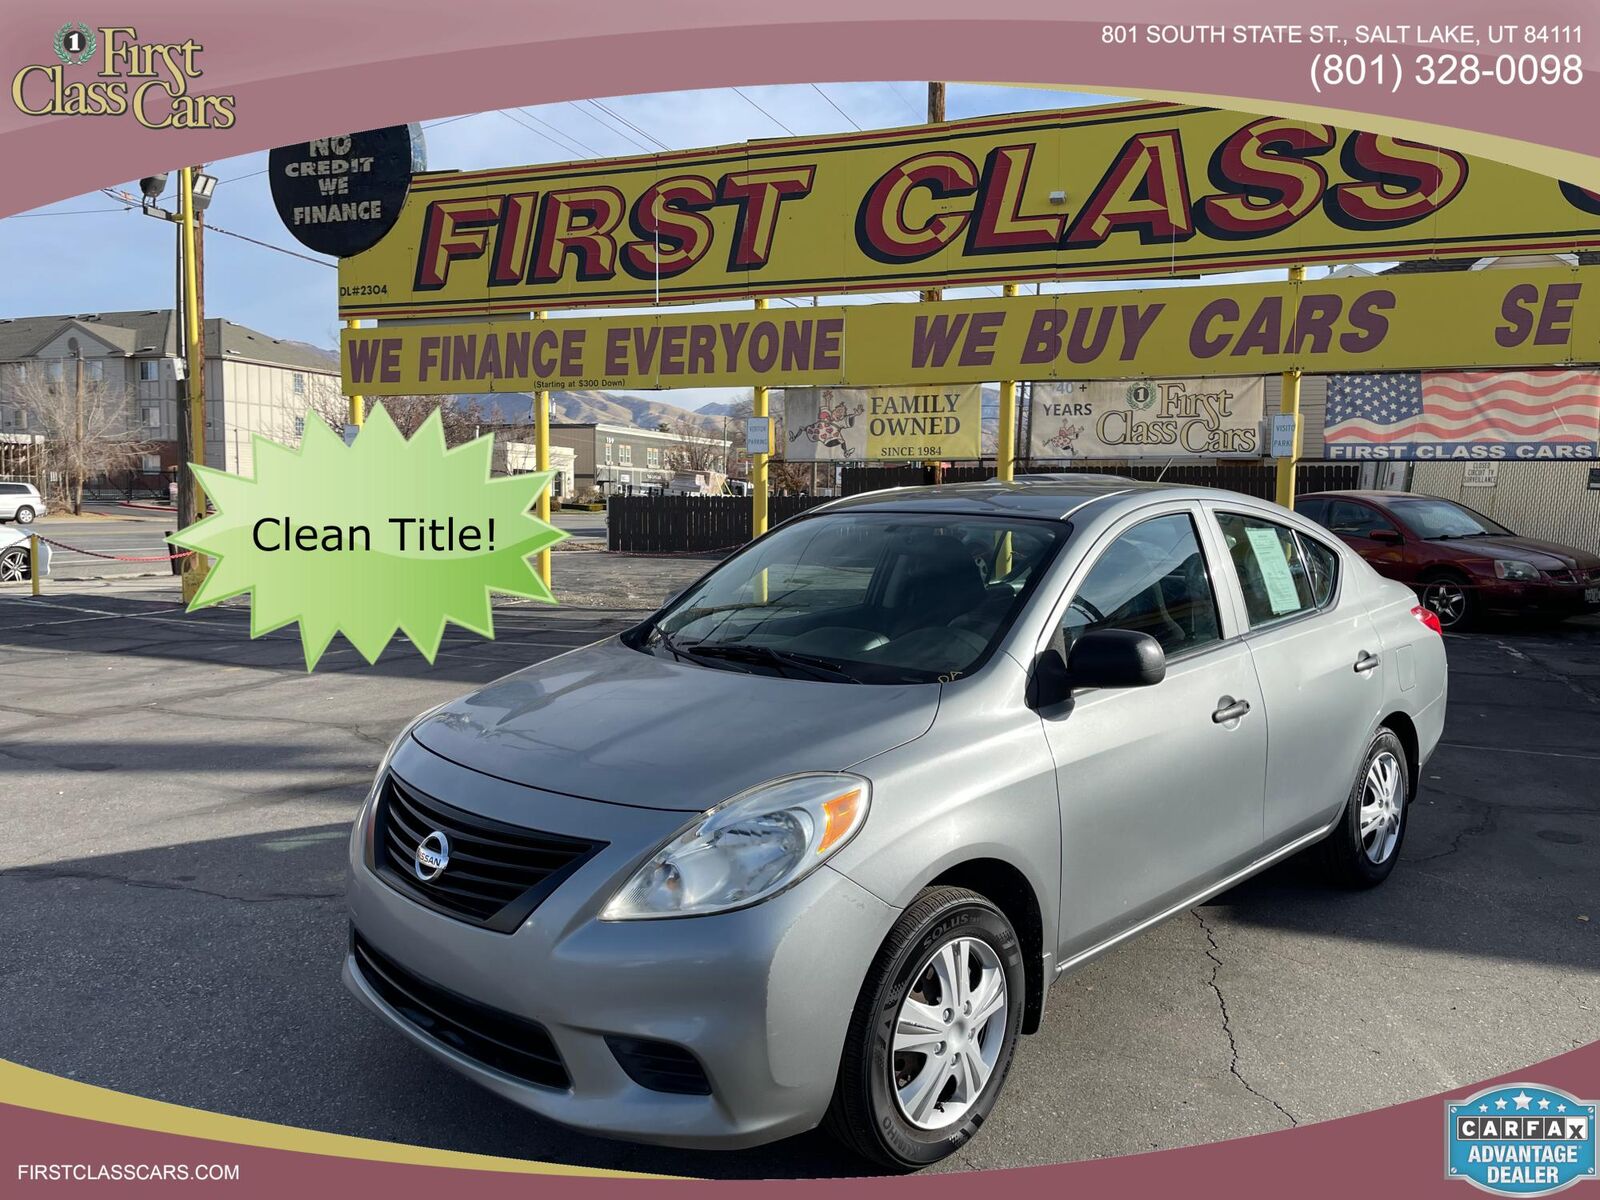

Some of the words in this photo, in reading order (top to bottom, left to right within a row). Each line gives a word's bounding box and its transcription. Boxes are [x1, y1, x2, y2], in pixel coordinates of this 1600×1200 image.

[309, 135, 352, 157] NO
[284, 157, 375, 178] CREDIT
[318, 176, 349, 196] WE
[293, 200, 382, 226] FINANCE
[413, 165, 817, 291] FIRST
[855, 115, 1469, 264] CLASS
[339, 284, 388, 296] DL#2304
[911, 311, 1006, 368] WE
[1020, 303, 1165, 364] BUY
[1188, 290, 1396, 358] CARS
[1494, 283, 1582, 348] SE
[348, 338, 402, 383] WE
[419, 329, 587, 382] FINANCE
[605, 319, 845, 376] EVERYONE
[533, 380, 566, 389] (Starting
[578, 379, 599, 387] $300
[601, 379, 626, 387] Down)
[871, 394, 961, 415] FAMILY
[1043, 403, 1092, 416] YEARS
[1157, 382, 1233, 431] First
[870, 415, 961, 436] OWNED
[1096, 410, 1178, 445] Class
[1179, 419, 1256, 453] Cars
[881, 447, 914, 456] SINCE
[918, 446, 942, 456] 1984
[1330, 446, 1407, 459] FIRST
[1416, 445, 1506, 459] CLASS
[1516, 445, 1592, 459] CARS
